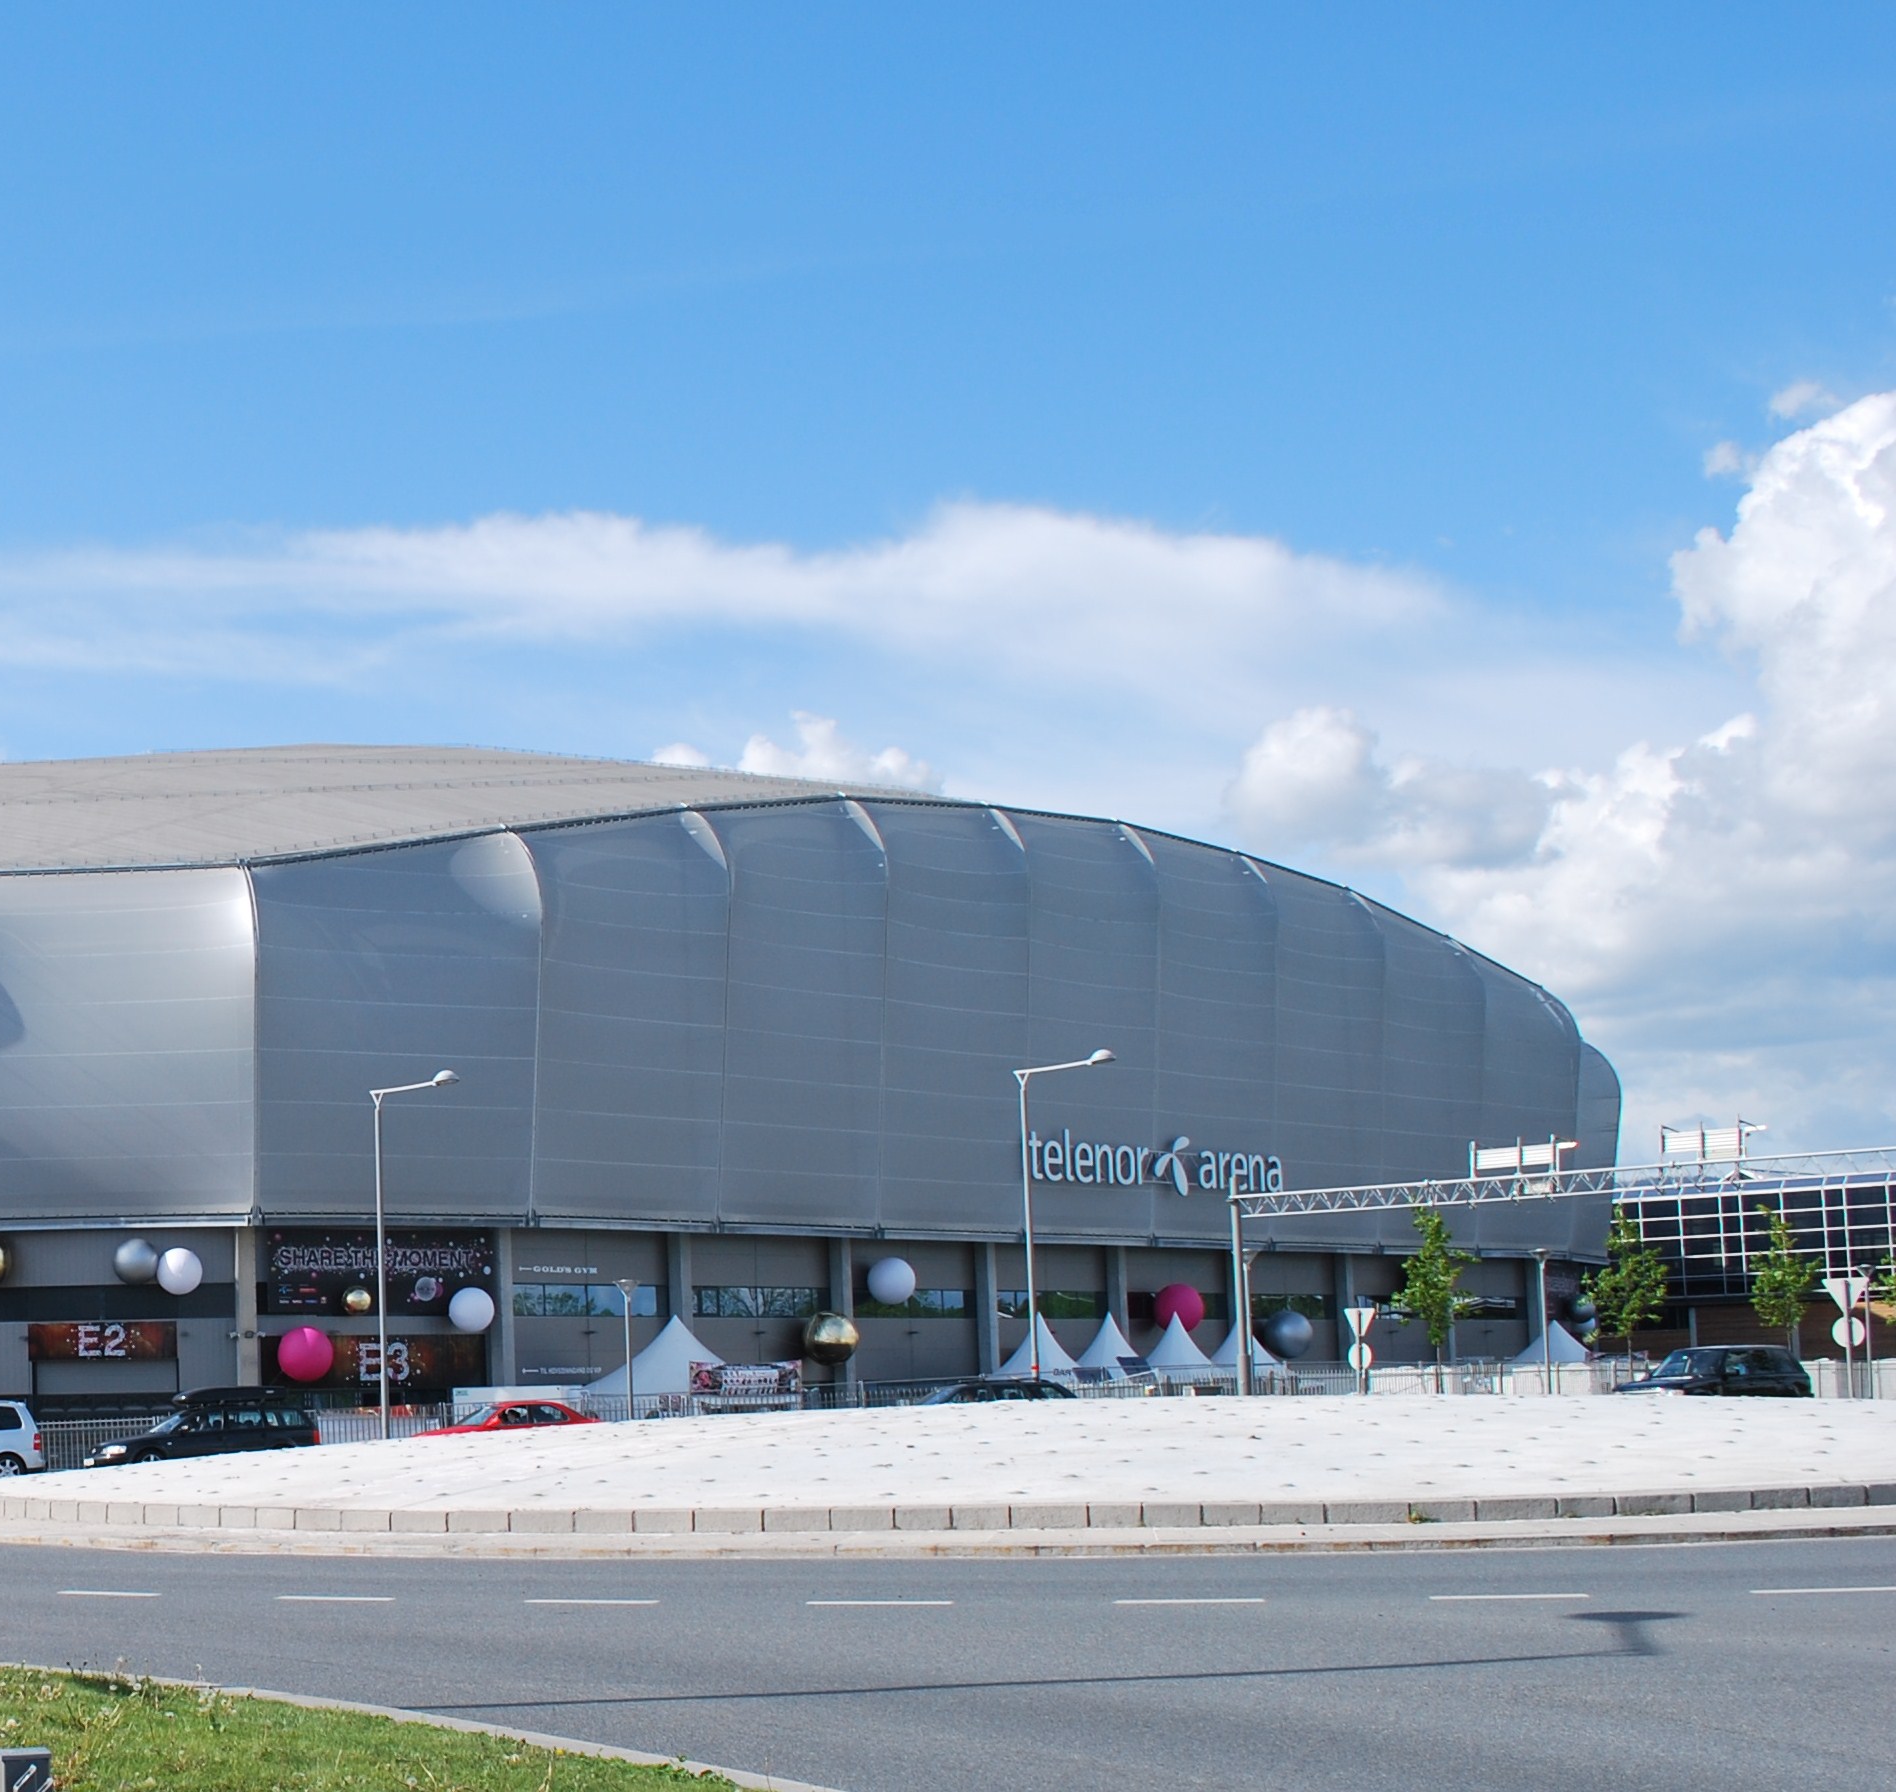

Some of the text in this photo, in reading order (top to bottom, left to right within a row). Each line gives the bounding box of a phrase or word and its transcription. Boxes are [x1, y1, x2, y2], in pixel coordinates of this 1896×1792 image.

[1028, 1129, 1284, 1193] telenor arena
[279, 1249, 346, 1268] SHARE
[391, 1249, 473, 1268] MOMENT
[77, 1324, 126, 1357] E2
[358, 1342, 410, 1381] E3
